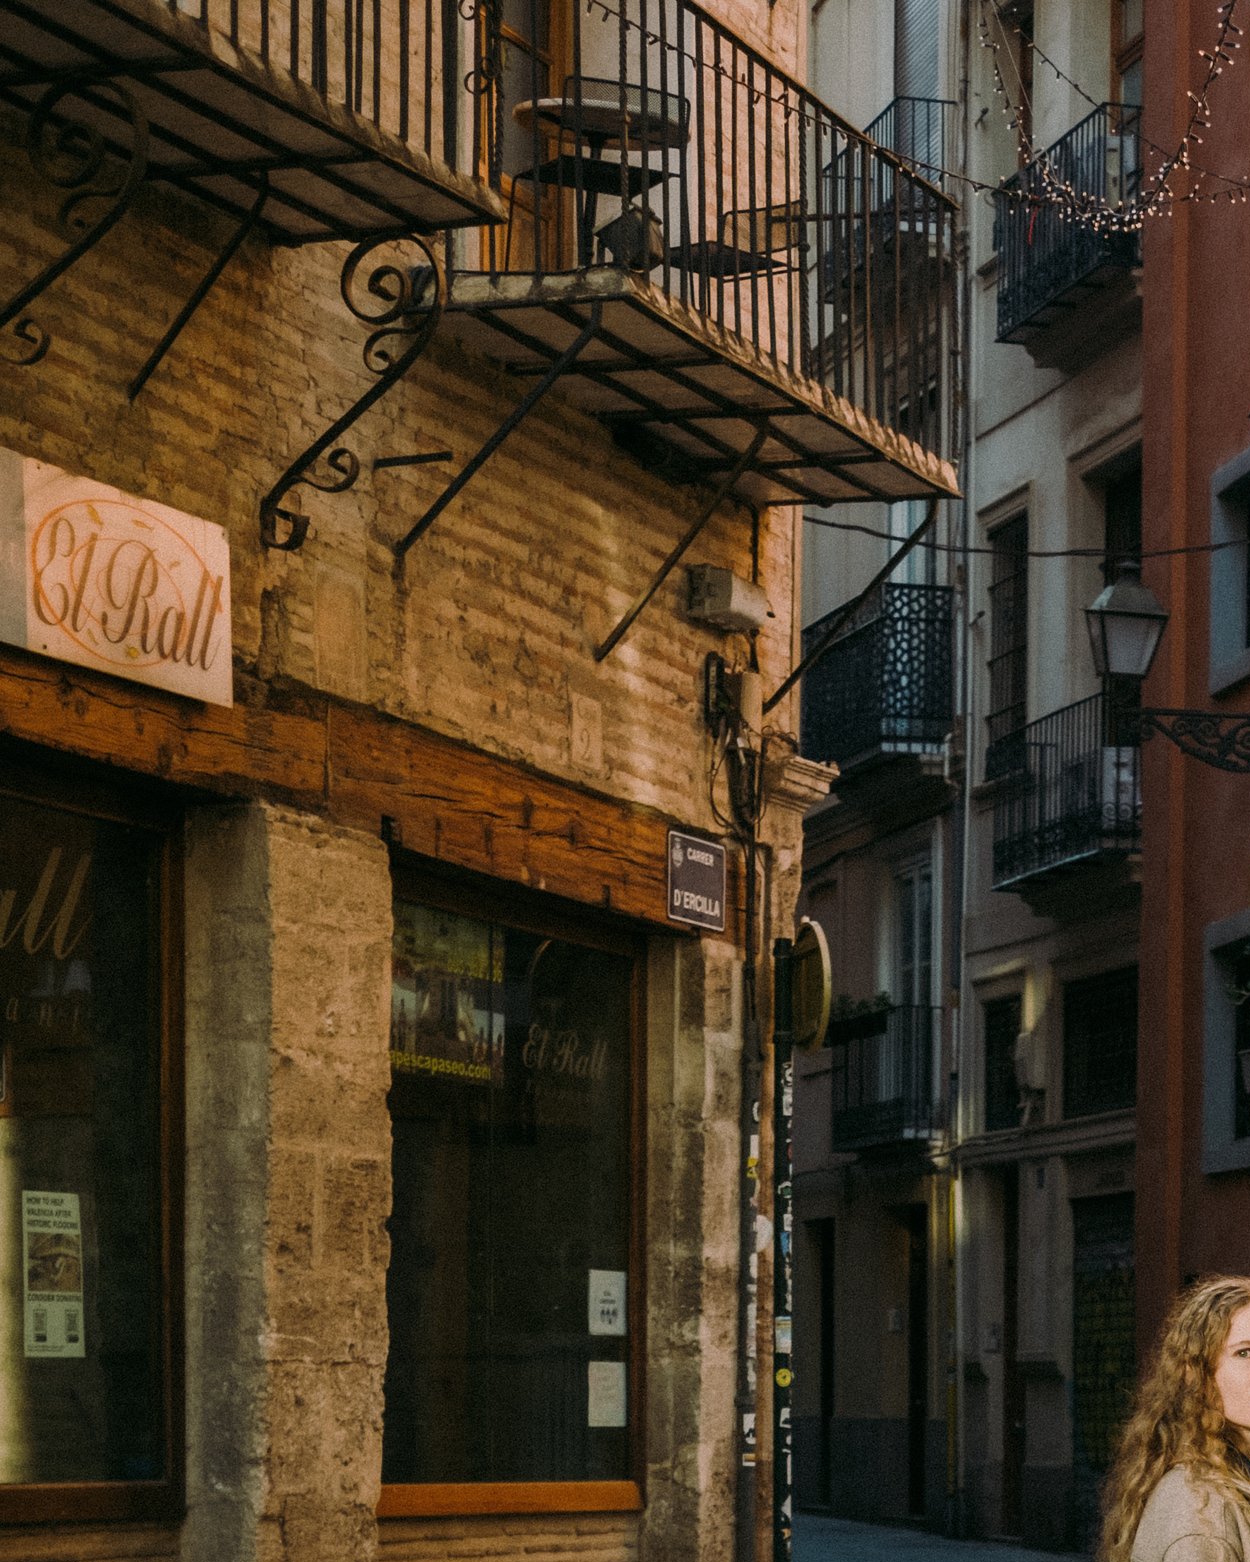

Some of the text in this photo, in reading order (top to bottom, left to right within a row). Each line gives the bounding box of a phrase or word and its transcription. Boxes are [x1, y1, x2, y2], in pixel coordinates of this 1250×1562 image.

[33, 518, 224, 671] El Rall
[687, 847, 714, 867] CARRER
[673, 889, 720, 917] D'ERCILLA
